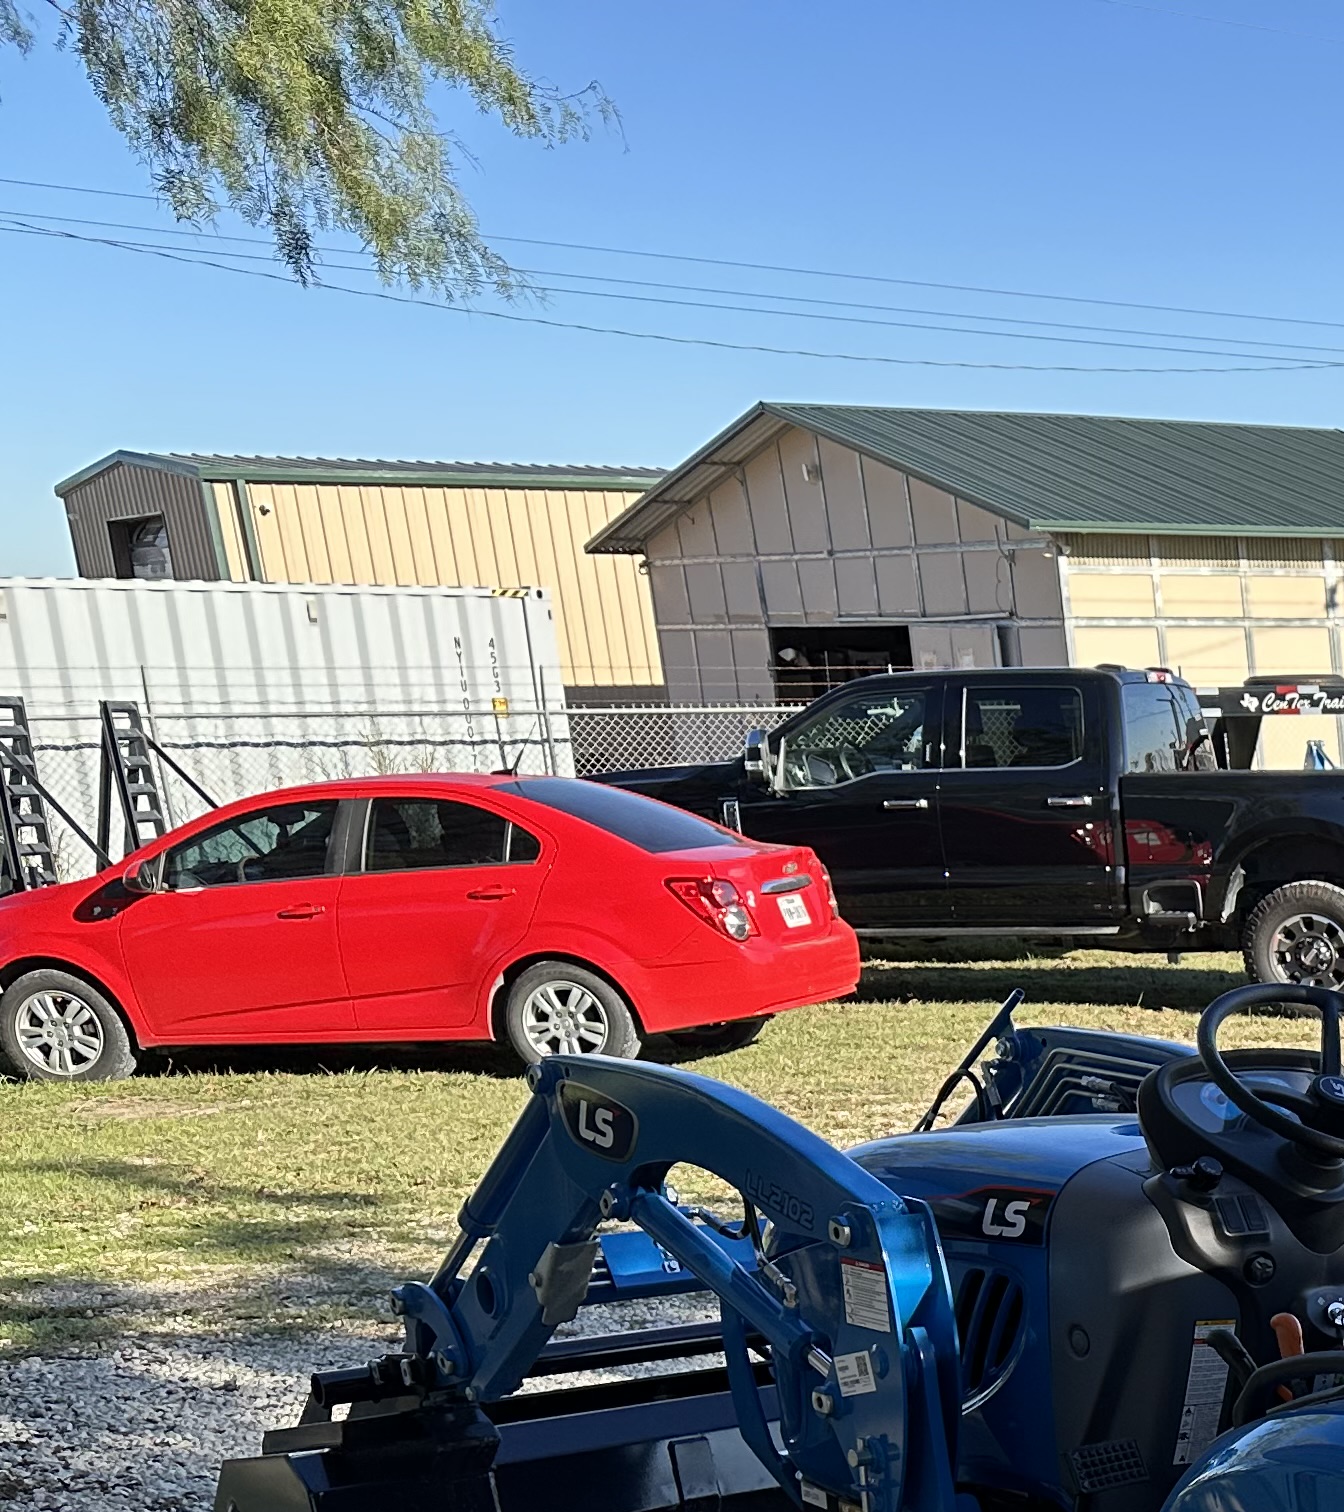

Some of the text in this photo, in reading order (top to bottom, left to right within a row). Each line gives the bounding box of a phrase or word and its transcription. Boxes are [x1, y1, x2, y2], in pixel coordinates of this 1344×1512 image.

[1261, 692, 1311, 712] CenTex
[578, 1099, 614, 1149] LS
[745, 1168, 815, 1232] LL2102
[981, 1198, 1031, 1238] LS
